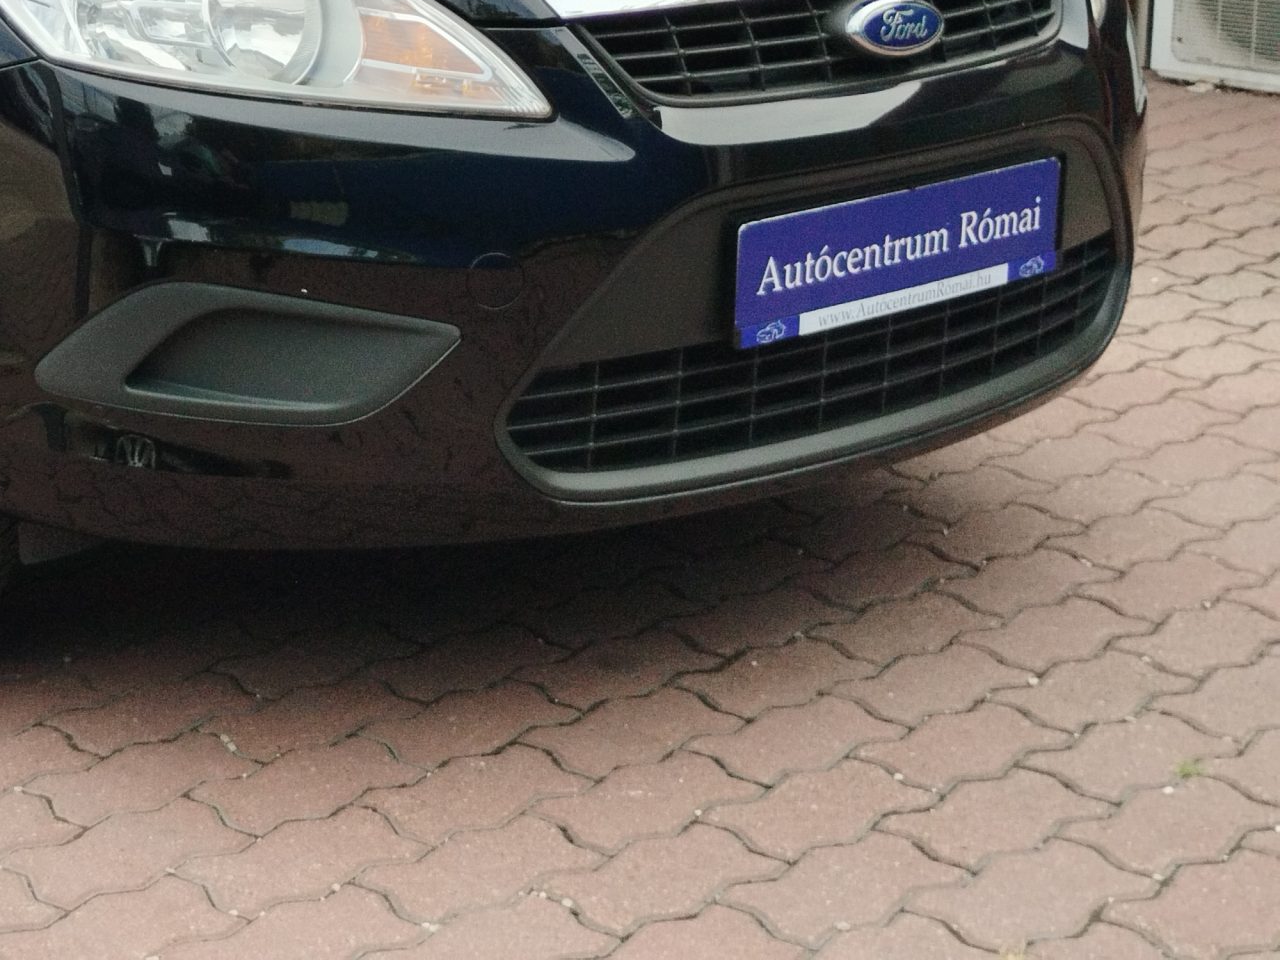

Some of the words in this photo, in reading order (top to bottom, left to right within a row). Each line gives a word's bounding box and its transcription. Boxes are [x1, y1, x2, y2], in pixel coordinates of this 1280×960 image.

[880, 8, 928, 42] Ford
[756, 224, 949, 296] Autócentrum
[959, 196, 1042, 248] Római
